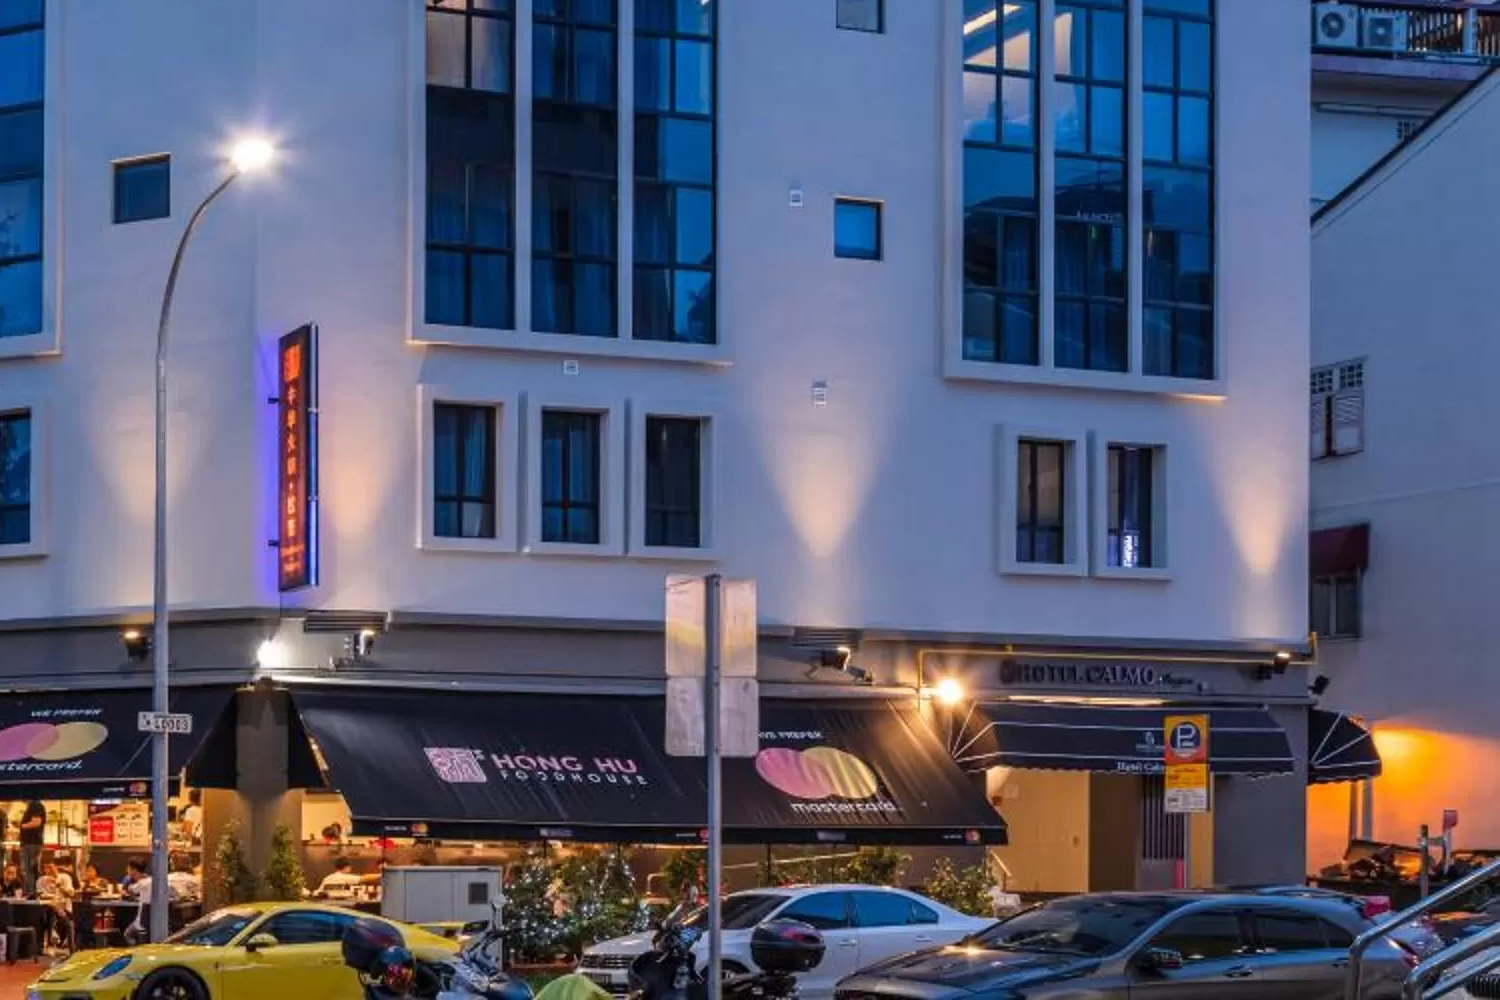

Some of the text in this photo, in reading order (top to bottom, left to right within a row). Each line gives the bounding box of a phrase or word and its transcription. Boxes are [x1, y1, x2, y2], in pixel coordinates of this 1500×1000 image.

[1085, 663, 1155, 686] CALMO
[490, 753, 638, 774] HONG HU
[499, 769, 649, 786] FOODHOUSE
[789, 800, 897, 814] mastercard
